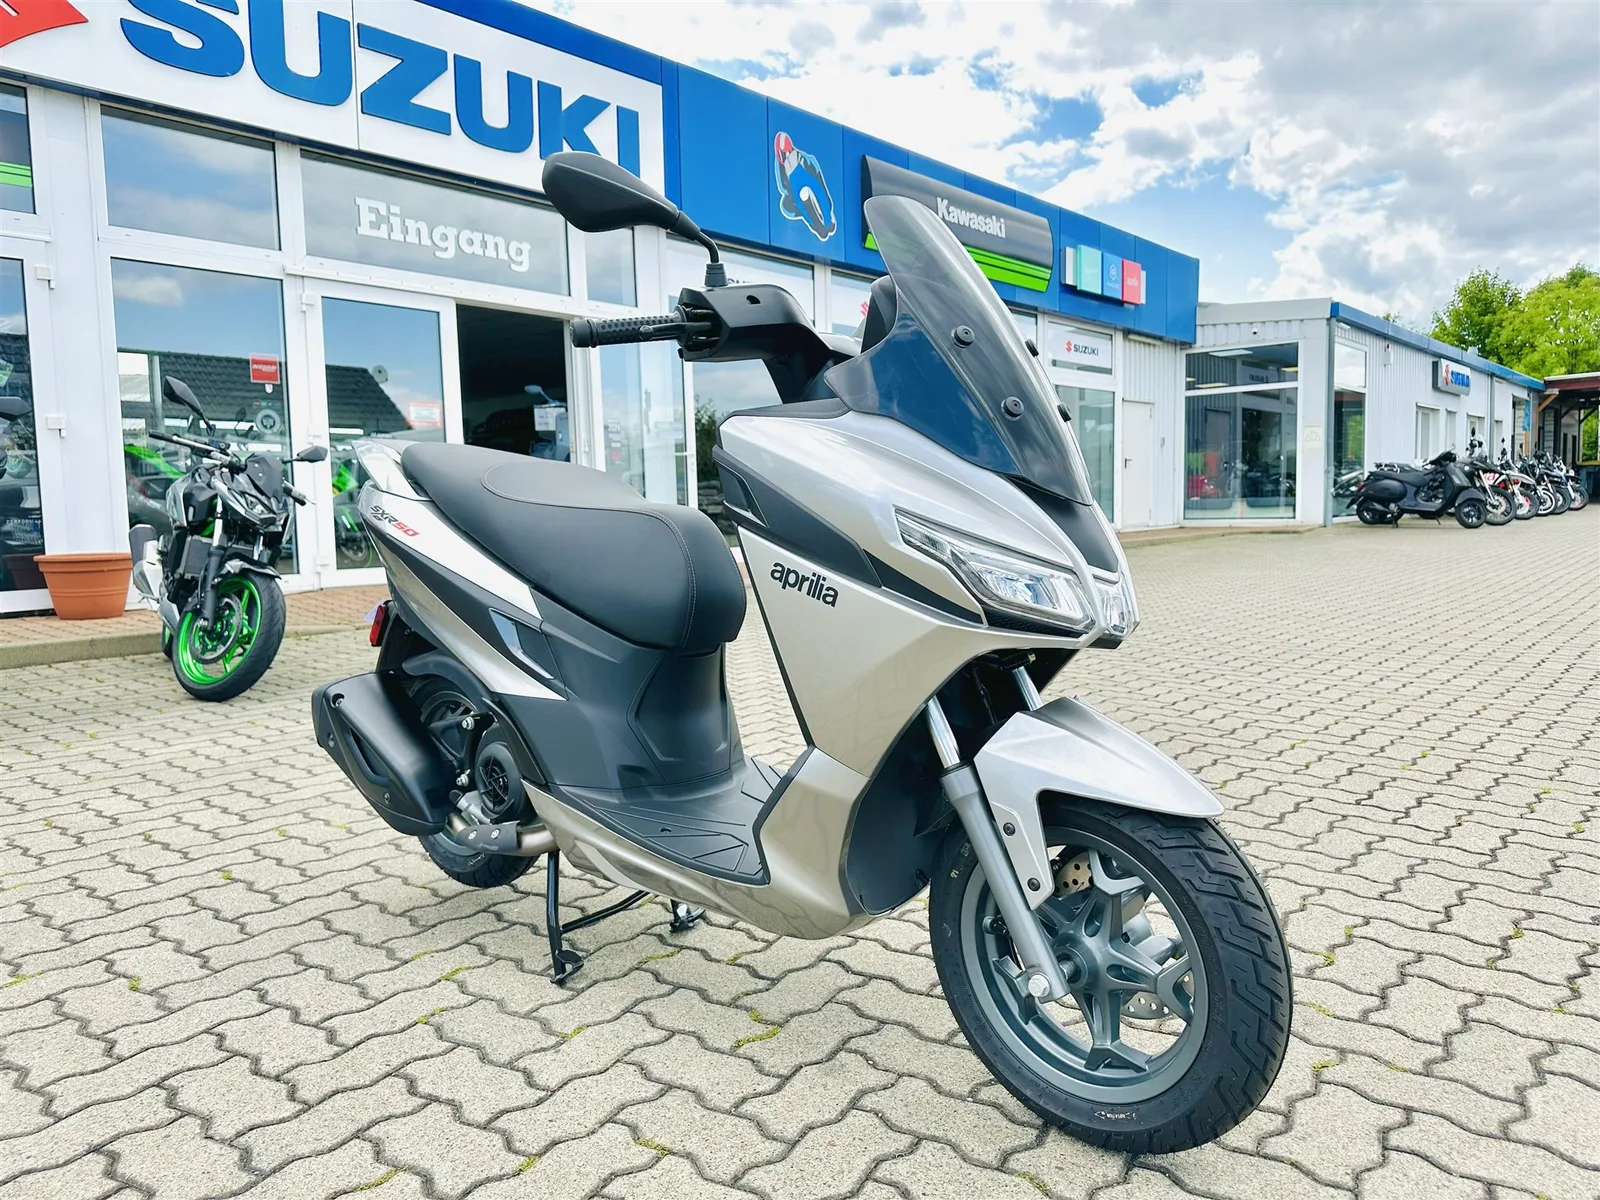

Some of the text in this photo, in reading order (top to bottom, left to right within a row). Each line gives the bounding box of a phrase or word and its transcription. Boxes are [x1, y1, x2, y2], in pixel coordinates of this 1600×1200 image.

[120, 0, 641, 178] SUZUKI
[354, 196, 531, 272] Eingang
[936, 196, 1006, 238] Kawasaki
[1073, 343, 1100, 356] SUZUKI
[370, 504, 420, 537] SXR50
[770, 561, 839, 608] aprilia
